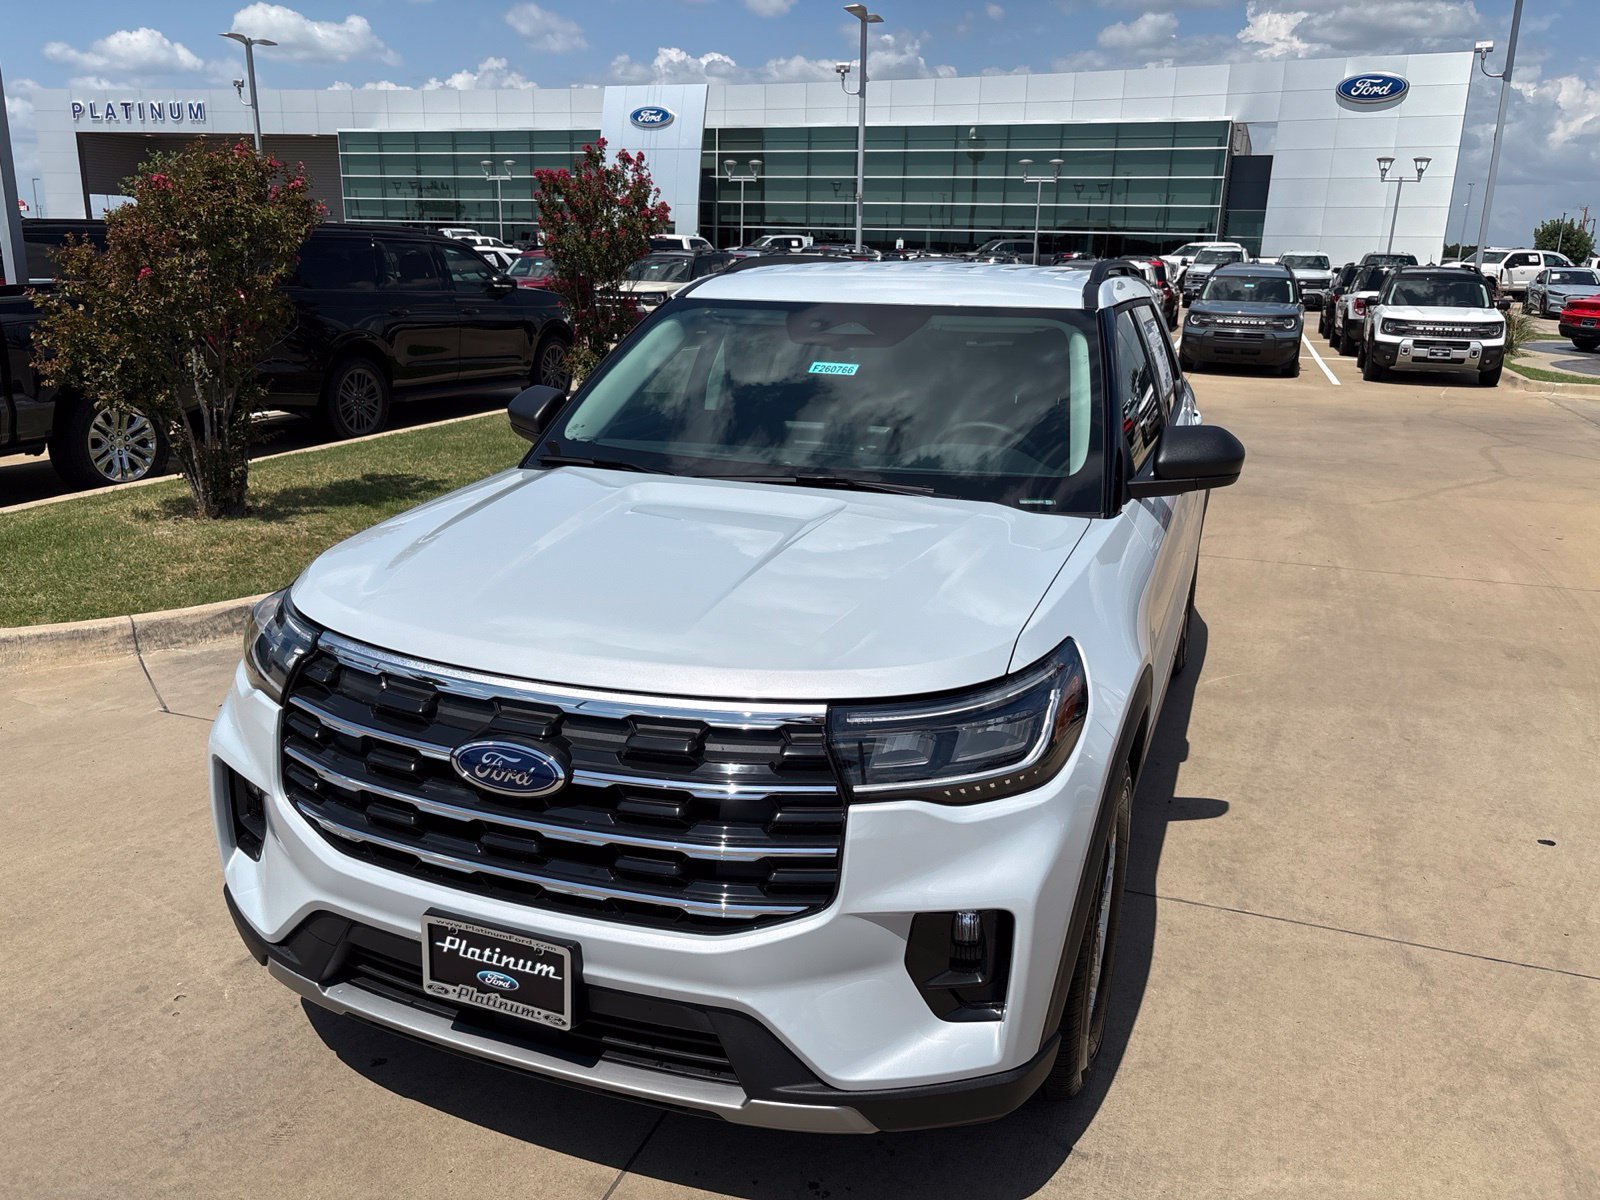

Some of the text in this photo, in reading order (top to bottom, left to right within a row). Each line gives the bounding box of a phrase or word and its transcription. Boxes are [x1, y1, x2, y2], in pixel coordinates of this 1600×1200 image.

[1351, 79, 1393, 95] Ford
[71, 101, 204, 121] PLATINUM
[637, 110, 663, 122] Ford
[812, 364, 855, 374] F260766
[475, 751, 536, 786] Ford
[435, 919, 558, 952] www.PlatinumFord.com
[435, 936, 563, 980] Platinum
[485, 973, 511, 989] Ford
[458, 986, 542, 1020] Platinum
